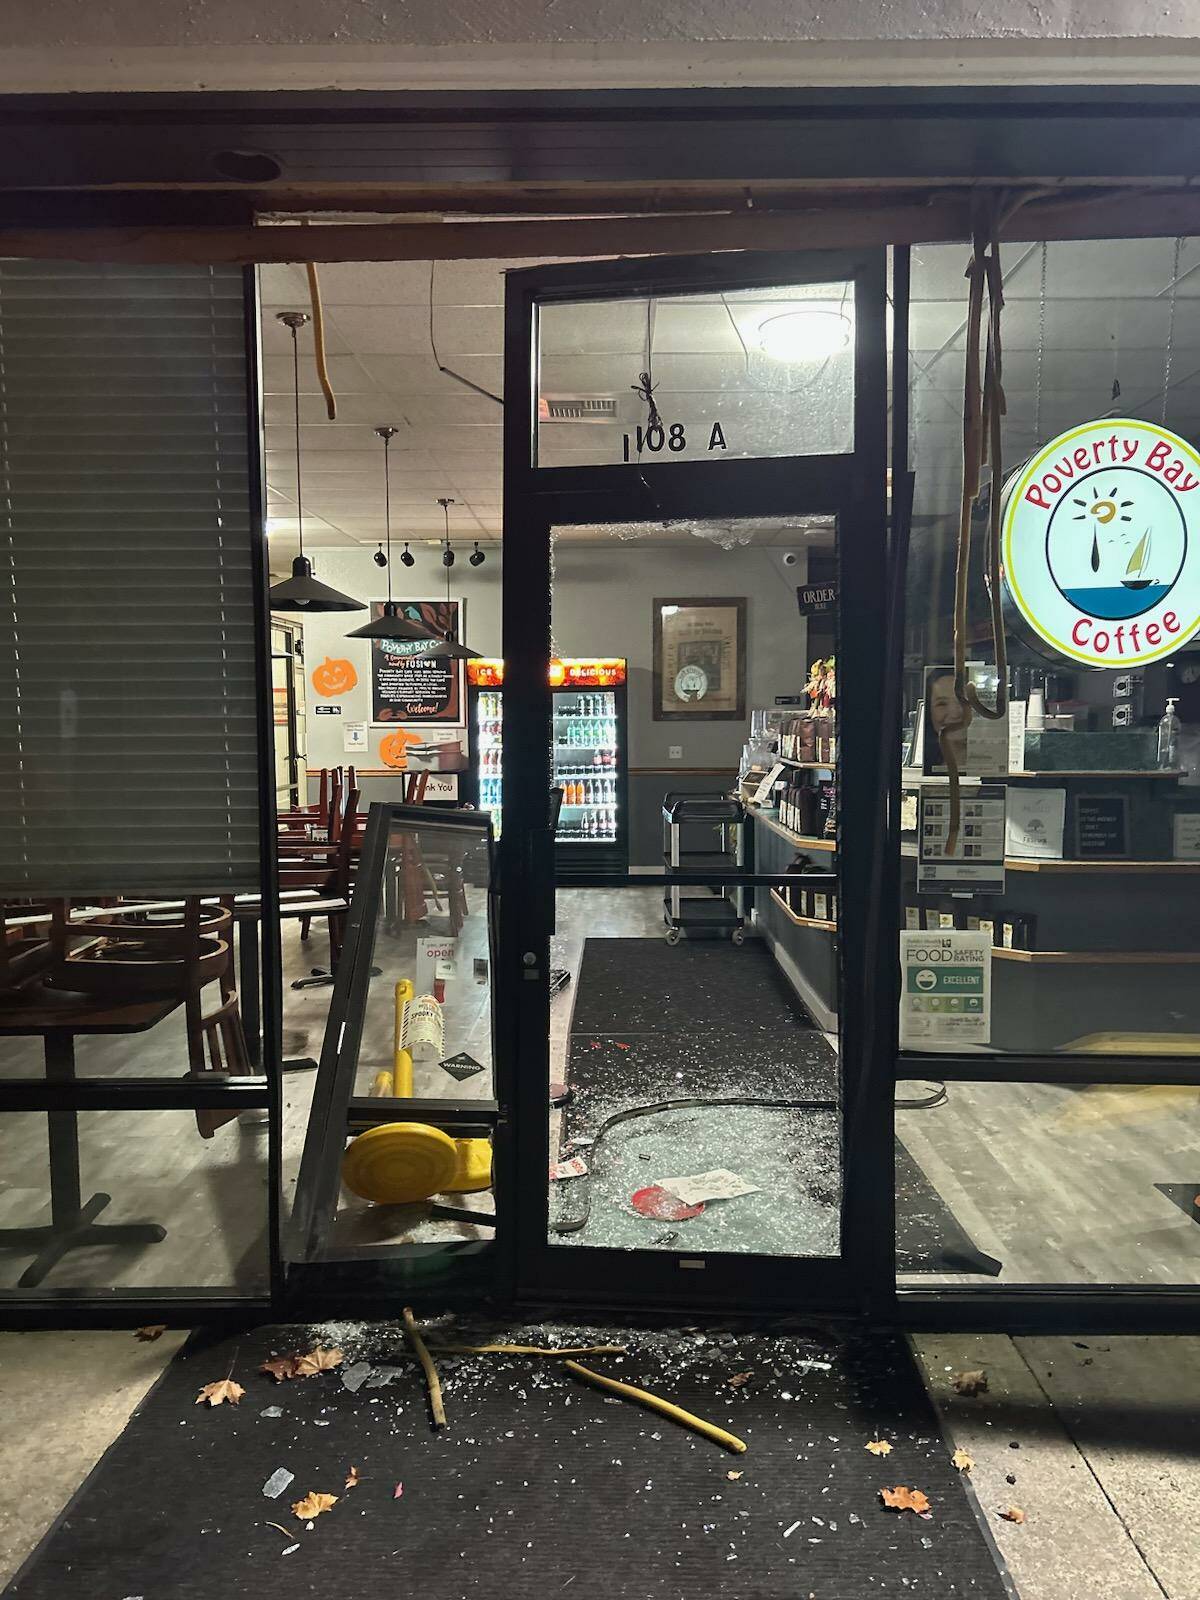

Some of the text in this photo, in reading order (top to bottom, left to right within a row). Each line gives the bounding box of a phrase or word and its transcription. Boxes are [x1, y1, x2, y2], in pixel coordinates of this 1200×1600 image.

[708, 422, 727, 450] A
[1025, 434, 1200, 510] Poverty Bay
[803, 588, 836, 604] ORDER
[1071, 611, 1181, 655] Coffee
[382, 639, 413, 654] POVERTY
[413, 640, 429, 652] BAY
[569, 668, 617, 677] DELICIOUS
[438, 783, 453, 792] You
[427, 949, 454, 958] open
[906, 949, 953, 962] FOOD
[943, 976, 980, 985] EXCELLENT
[443, 1061, 481, 1071] WARNING
